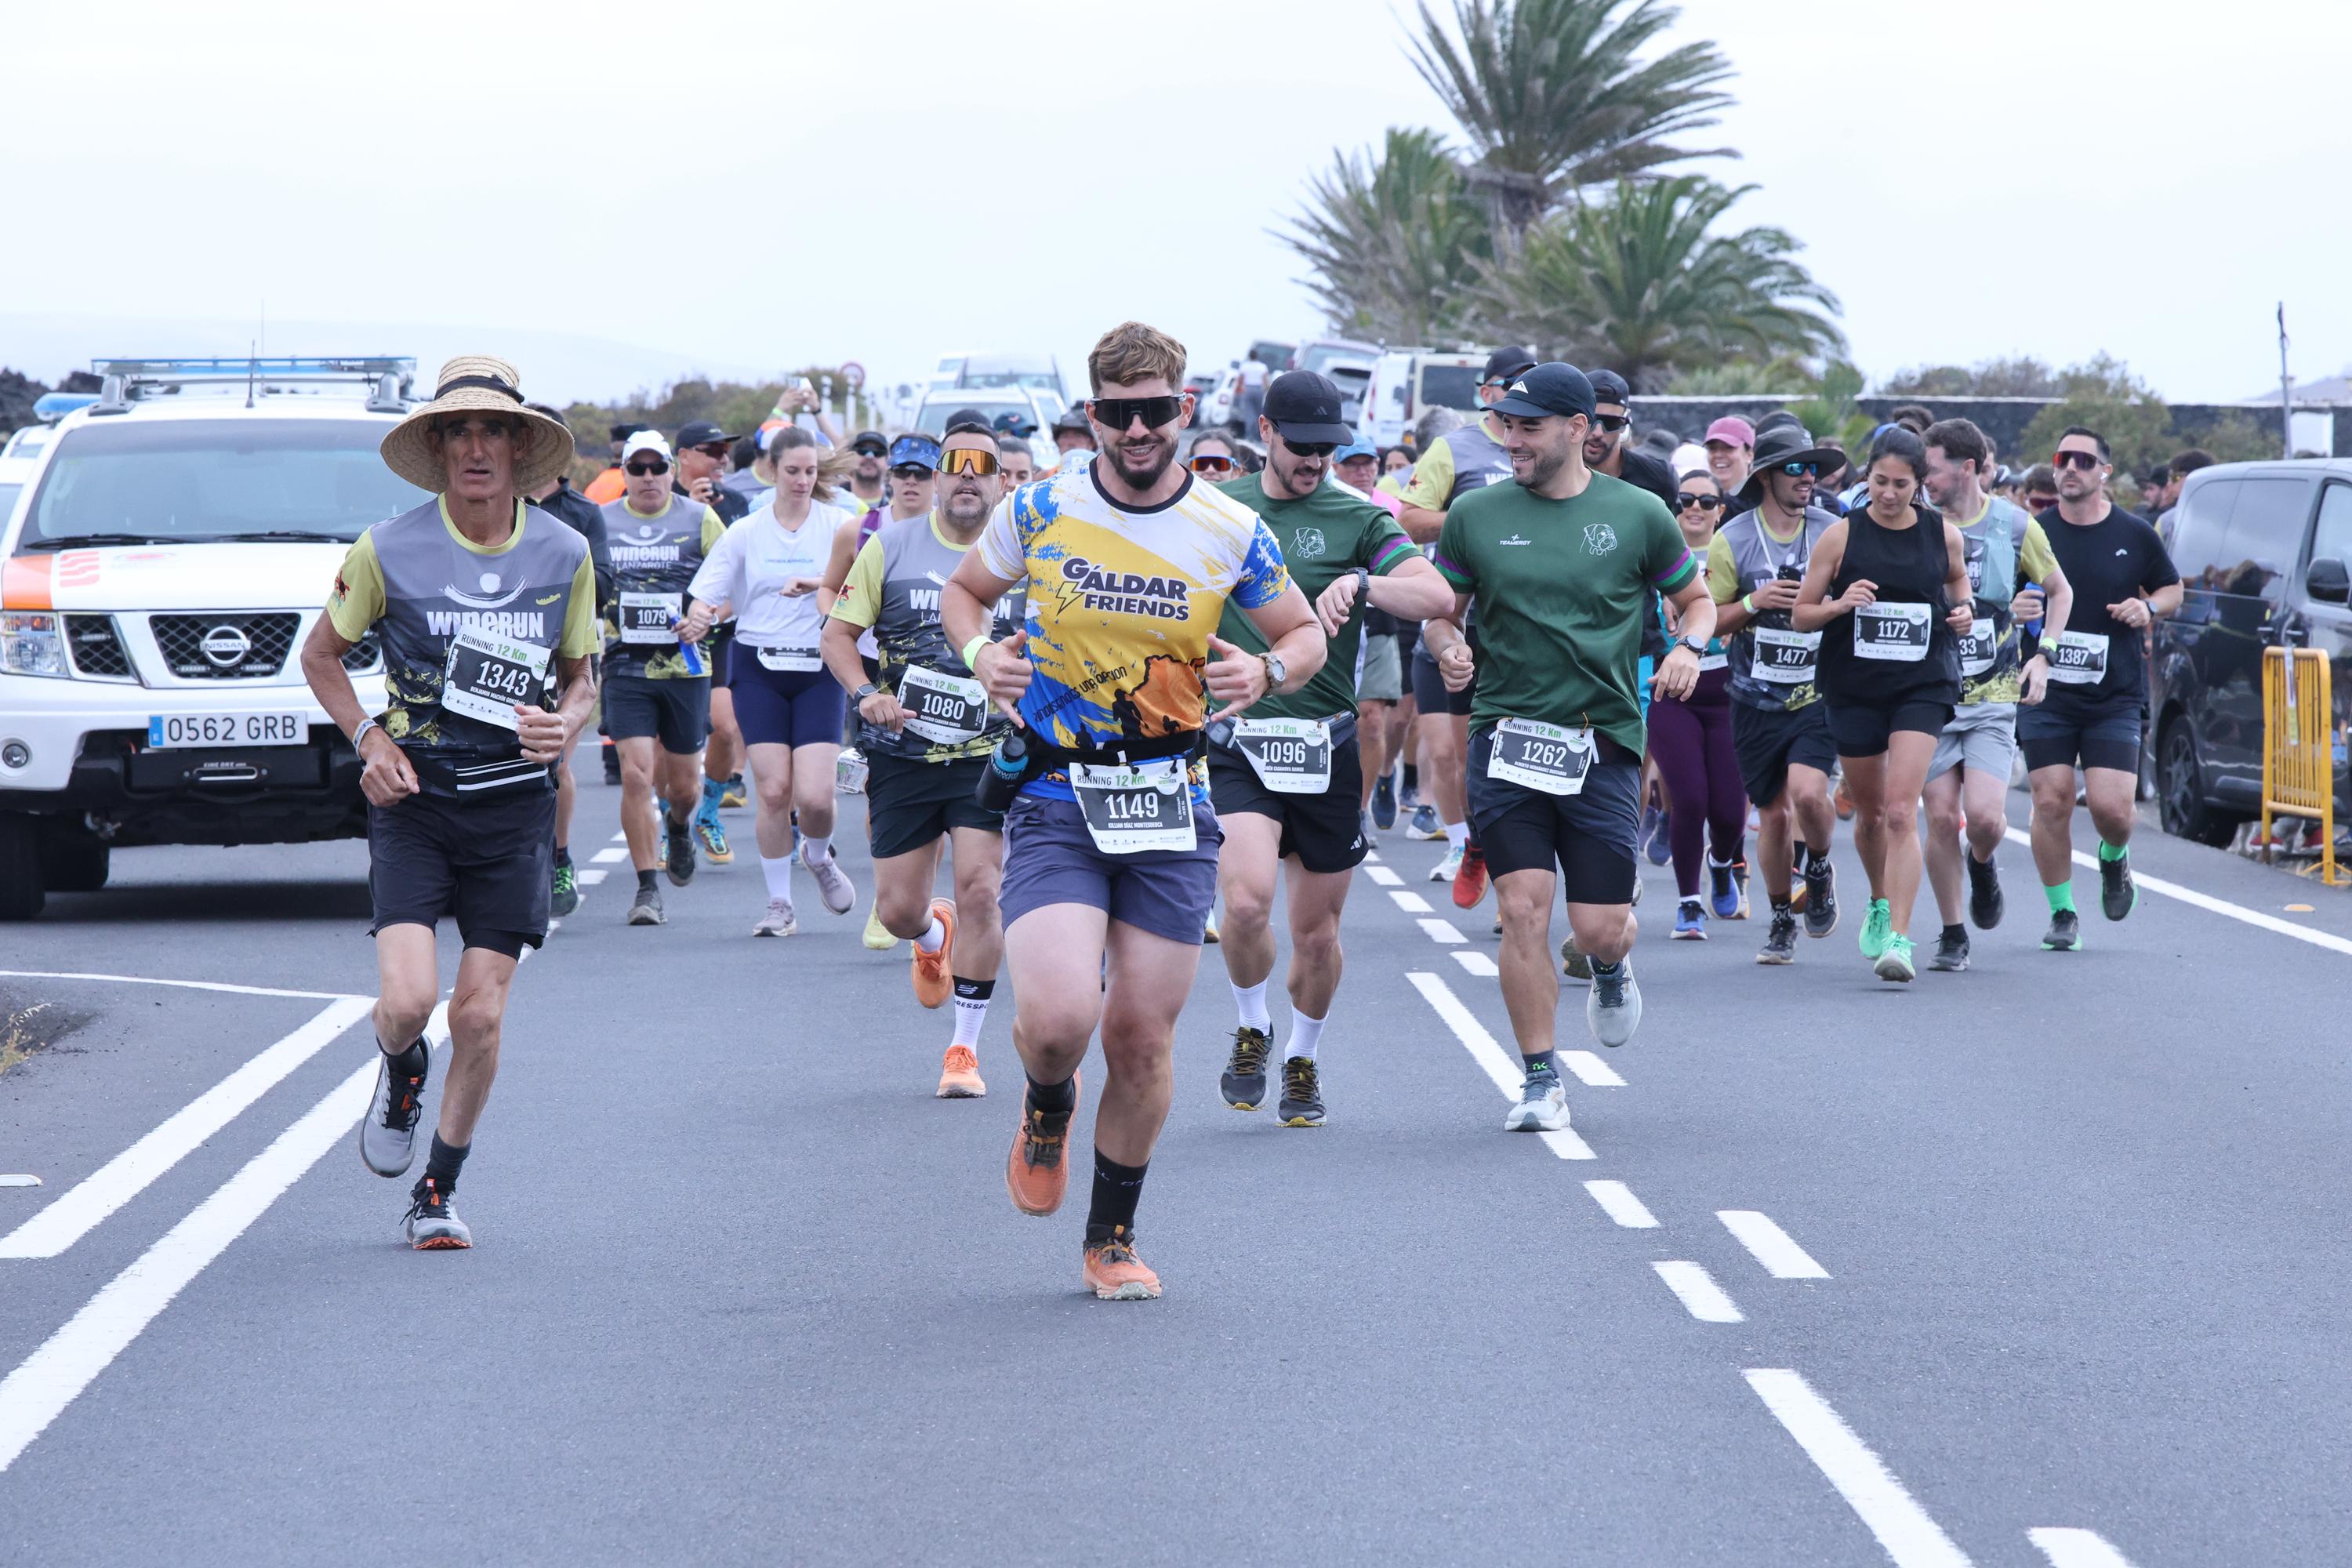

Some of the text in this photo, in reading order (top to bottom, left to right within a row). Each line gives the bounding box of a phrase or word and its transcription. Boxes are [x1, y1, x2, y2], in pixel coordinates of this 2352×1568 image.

[616, 561, 672, 571] LANZAROTE
[1062, 557, 1188, 602] GÁLDAR
[637, 609, 667, 625] 1079
[1083, 593, 1190, 622] FRIENDS
[1878, 620, 1909, 639] 1172
[205, 641, 245, 650] NISSAN
[461, 633, 495, 652] RUNNING
[496, 644, 510, 658] 12
[510, 649, 528, 662] Km
[1958, 638, 1976, 655] 33
[1776, 648, 1808, 665] 1477
[2058, 648, 2089, 665] 1387
[476, 660, 530, 696] 1343
[909, 673, 960, 693] RUNNING 12 Km
[921, 693, 966, 720] 1080
[168, 715, 296, 742] 0562 GRB
[1270, 724, 1280, 734] 12
[1283, 724, 1297, 735] Km
[1504, 721, 1561, 739] RUNNING 12 Km
[1260, 741, 1305, 764] 1096
[1521, 740, 1567, 768] 1262
[1077, 775, 1146, 786] RUNNING 12 Km
[1105, 792, 1160, 820] 1149
